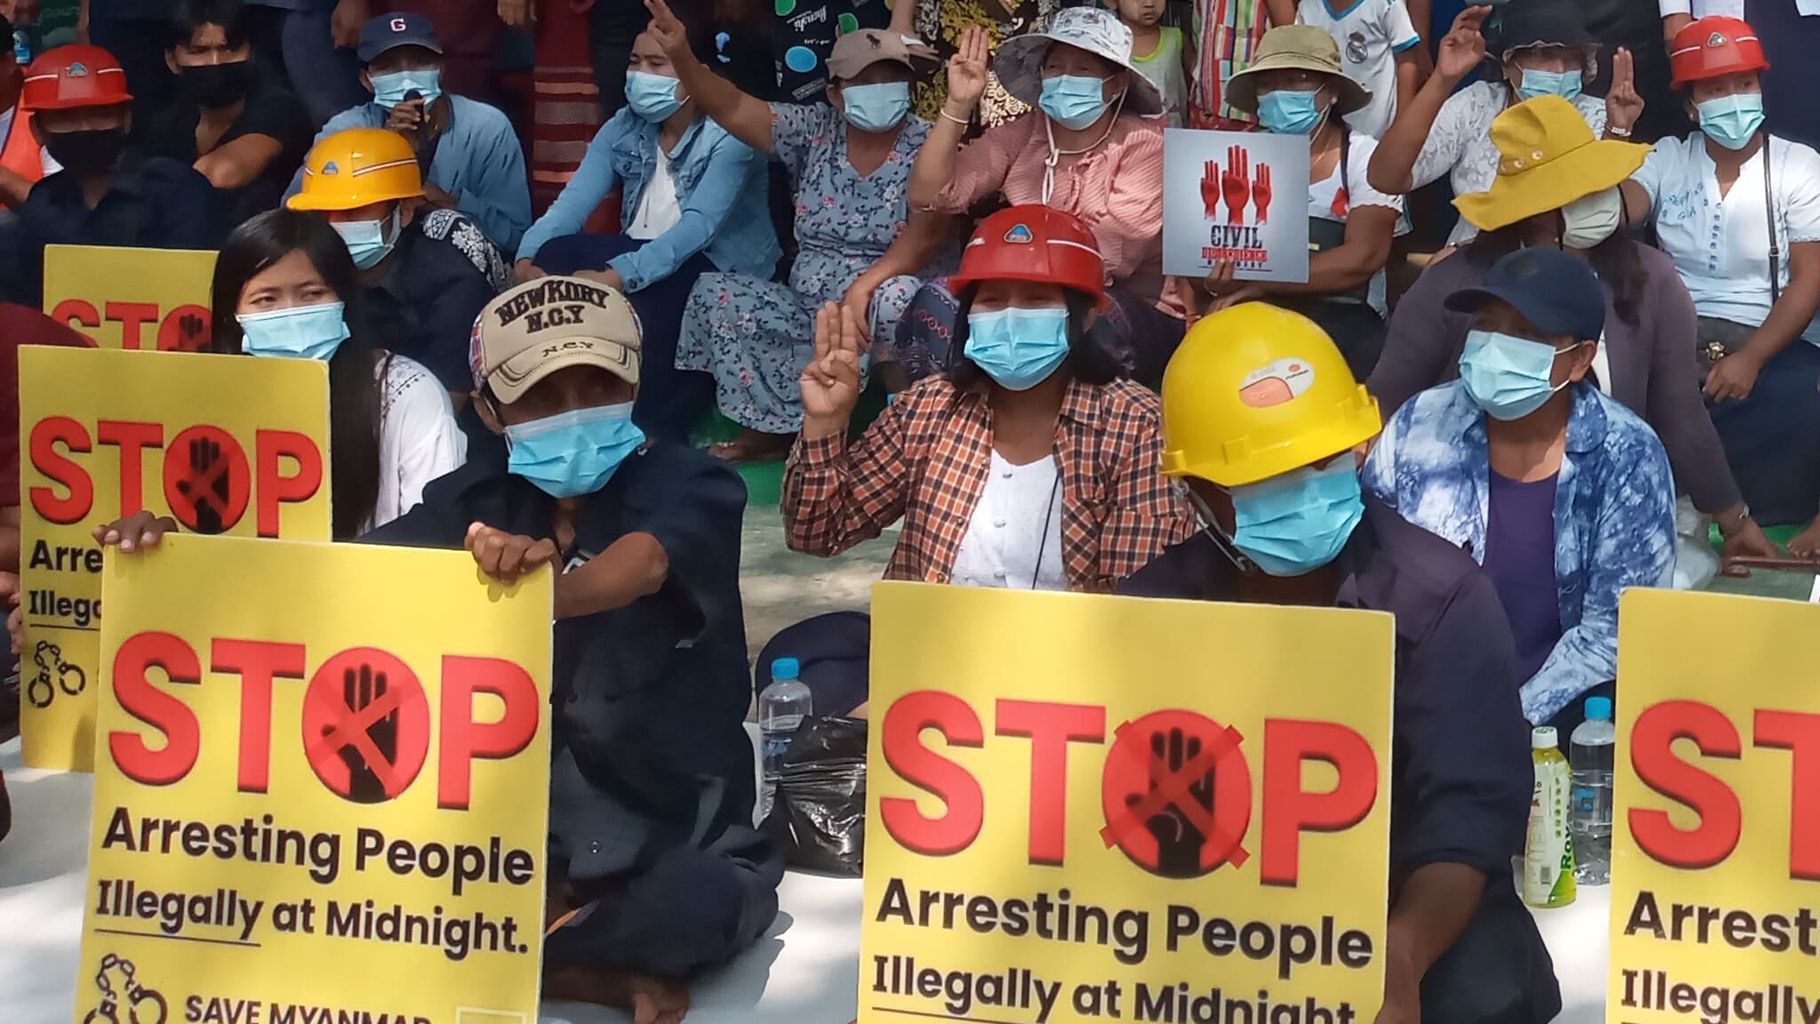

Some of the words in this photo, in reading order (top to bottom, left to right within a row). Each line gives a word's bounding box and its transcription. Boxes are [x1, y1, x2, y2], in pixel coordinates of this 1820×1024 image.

[1211, 224, 1263, 249] CIVIL
[51, 299, 213, 351] STO
[28, 416, 325, 540] STOP
[108, 630, 540, 811] STOP
[880, 689, 1379, 889] STOP
[101, 806, 342, 882] Arresting
[356, 828, 535, 895] People
[96, 880, 264, 941] Illegally
[273, 896, 316, 933] at
[326, 900, 529, 960] Midnight.
[875, 877, 1149, 965] Arresting
[1166, 904, 1373, 980] People
[185, 995, 262, 1024] SAVE
[873, 955, 1061, 1024] Illegally
[1072, 979, 1121, 1019] at
